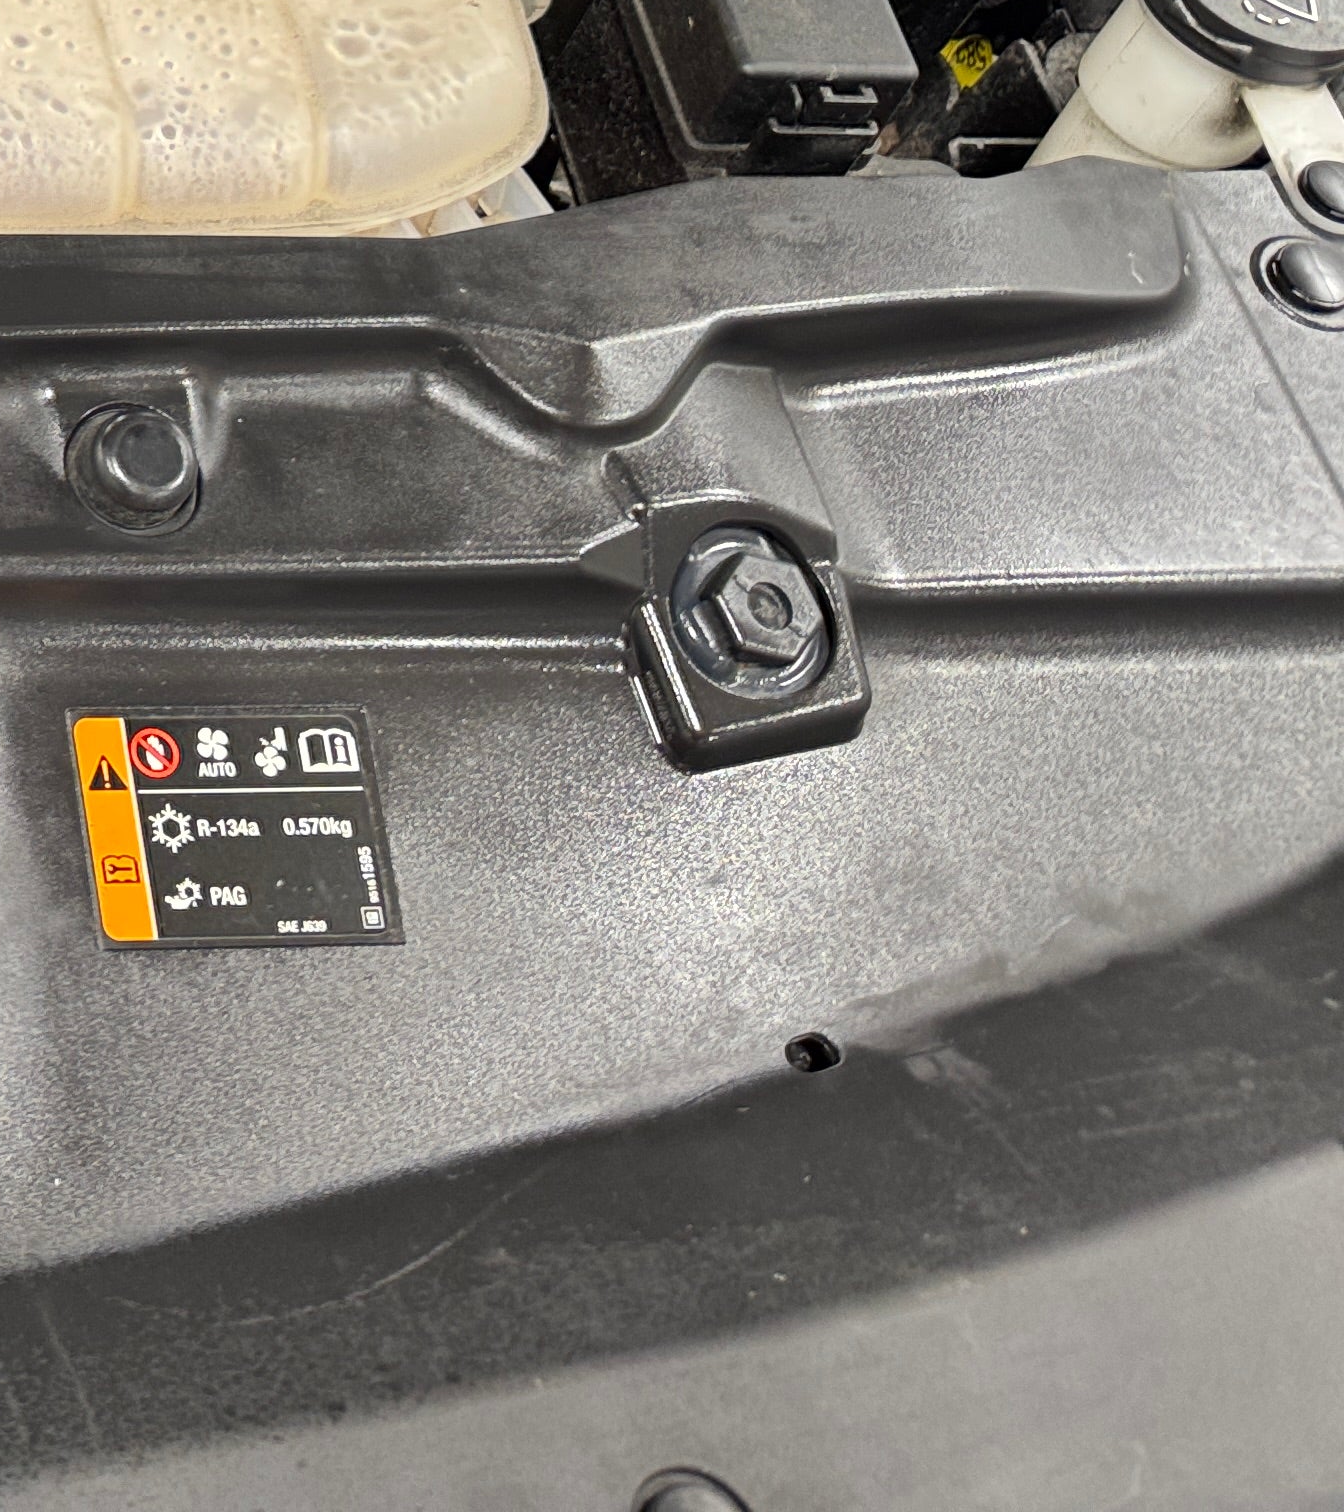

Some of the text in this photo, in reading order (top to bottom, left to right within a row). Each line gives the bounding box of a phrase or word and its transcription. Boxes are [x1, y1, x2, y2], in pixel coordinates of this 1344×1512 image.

[198, 763, 237, 778] AUTO
[197, 817, 353, 838] R-134a 0.570kg
[210, 886, 248, 906] PAG
[277, 920, 300, 933] SAE
